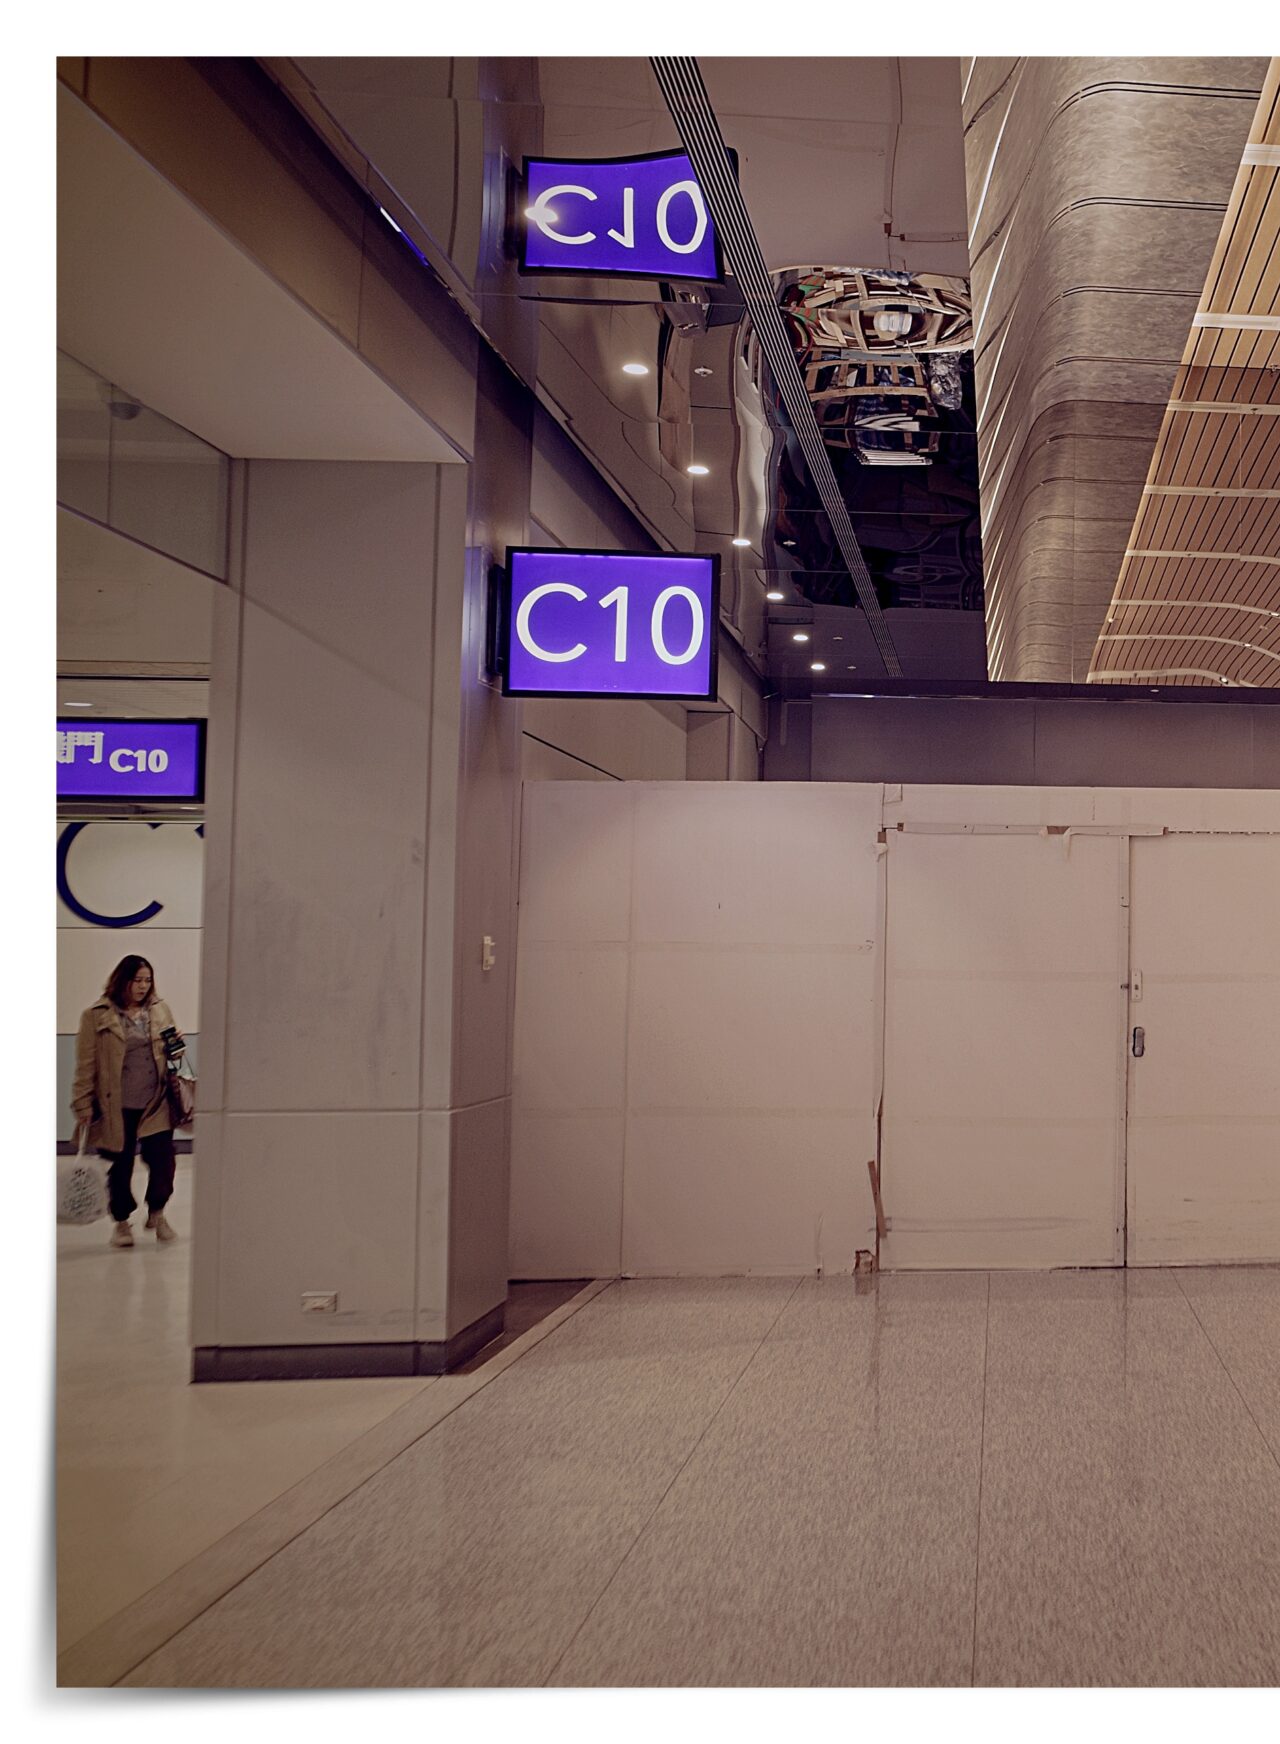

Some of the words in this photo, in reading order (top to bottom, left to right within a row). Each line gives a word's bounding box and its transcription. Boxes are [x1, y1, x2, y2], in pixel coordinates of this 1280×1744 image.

[516, 582, 704, 665] C10
[57, 731, 104, 764] 門
[109, 748, 169, 773] C10
